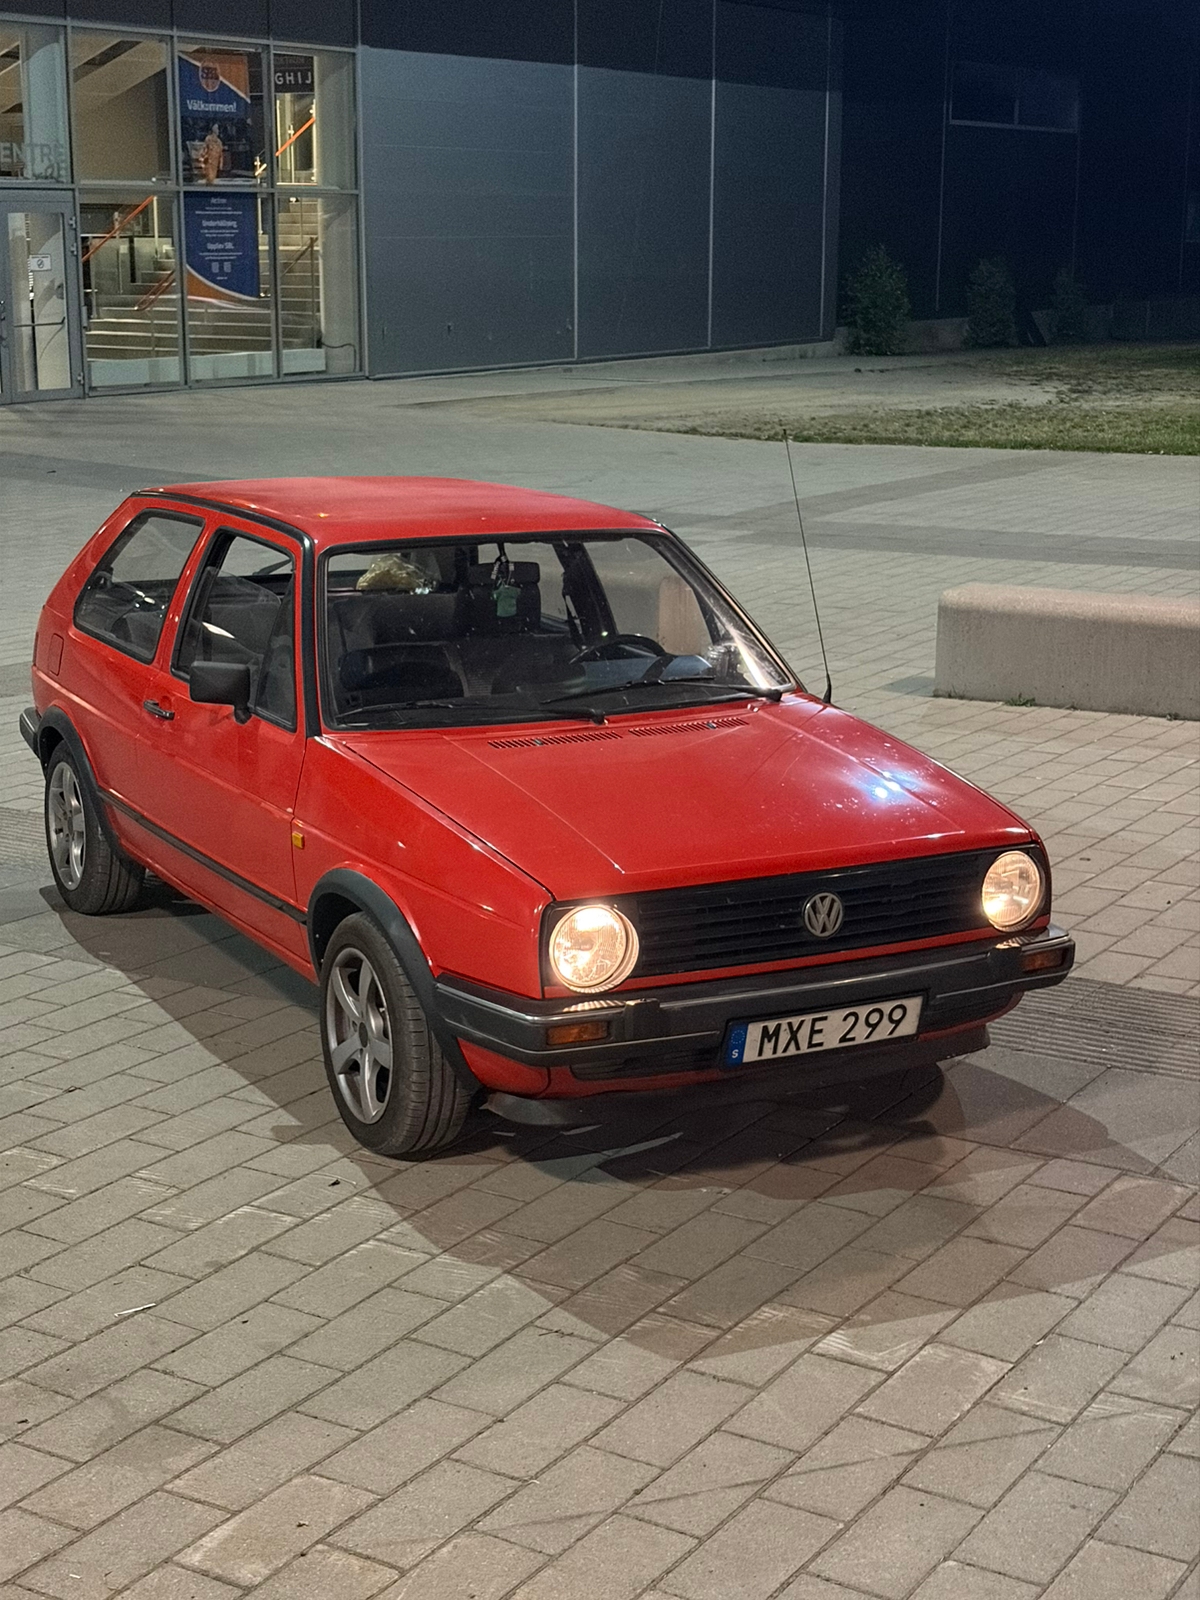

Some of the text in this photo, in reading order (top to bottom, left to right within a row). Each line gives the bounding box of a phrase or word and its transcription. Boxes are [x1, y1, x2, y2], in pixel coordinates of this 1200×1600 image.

[186, 99, 237, 113] Välkommen!
[804, 892, 843, 938] VW
[757, 1003, 908, 1058] MXE 299
[731, 1048, 739, 1059] S
